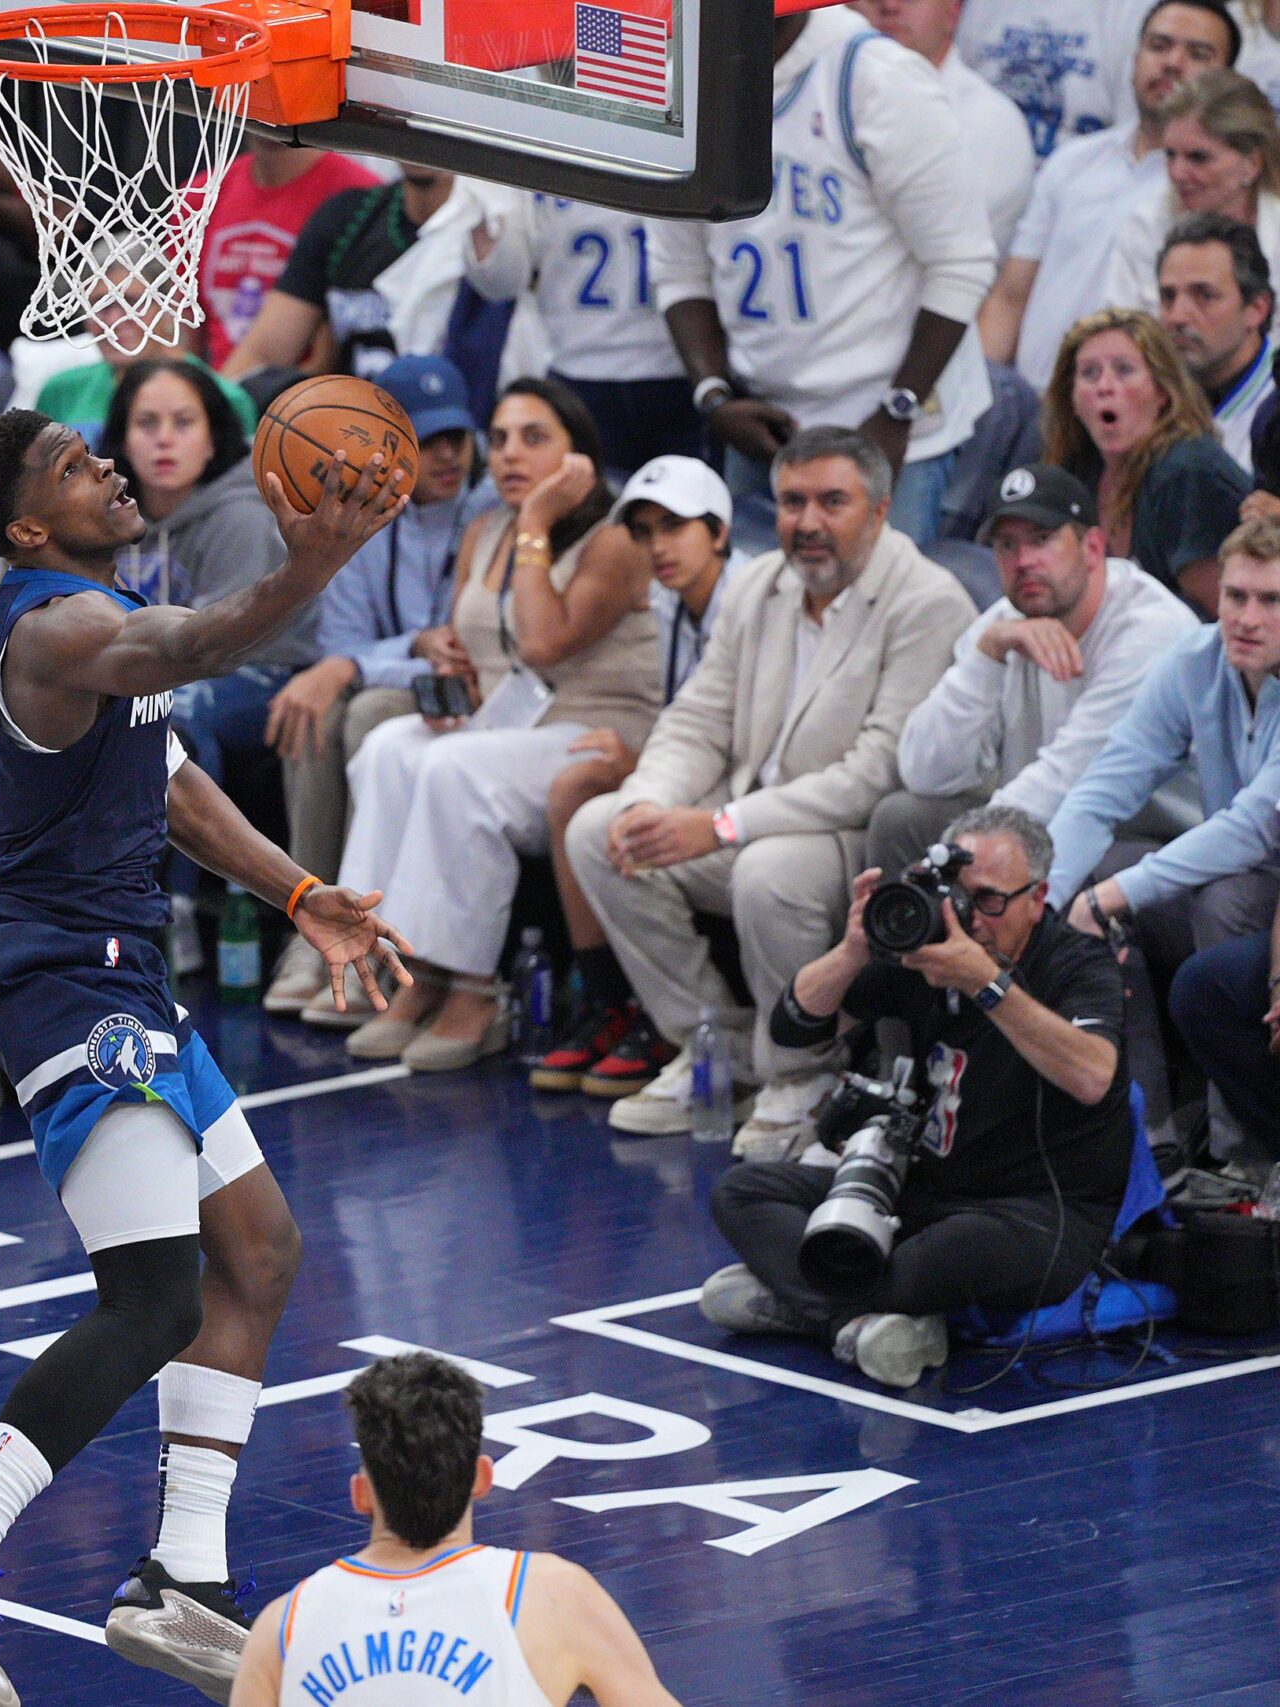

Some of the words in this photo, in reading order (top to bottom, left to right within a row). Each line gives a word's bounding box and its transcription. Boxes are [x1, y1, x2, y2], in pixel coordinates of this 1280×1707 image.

[572, 225, 650, 306] 21
[730, 239, 810, 320] 21
[89, 1020, 115, 1070] MINNESOTA
[300, 1630, 493, 1707] HOLMGREN
